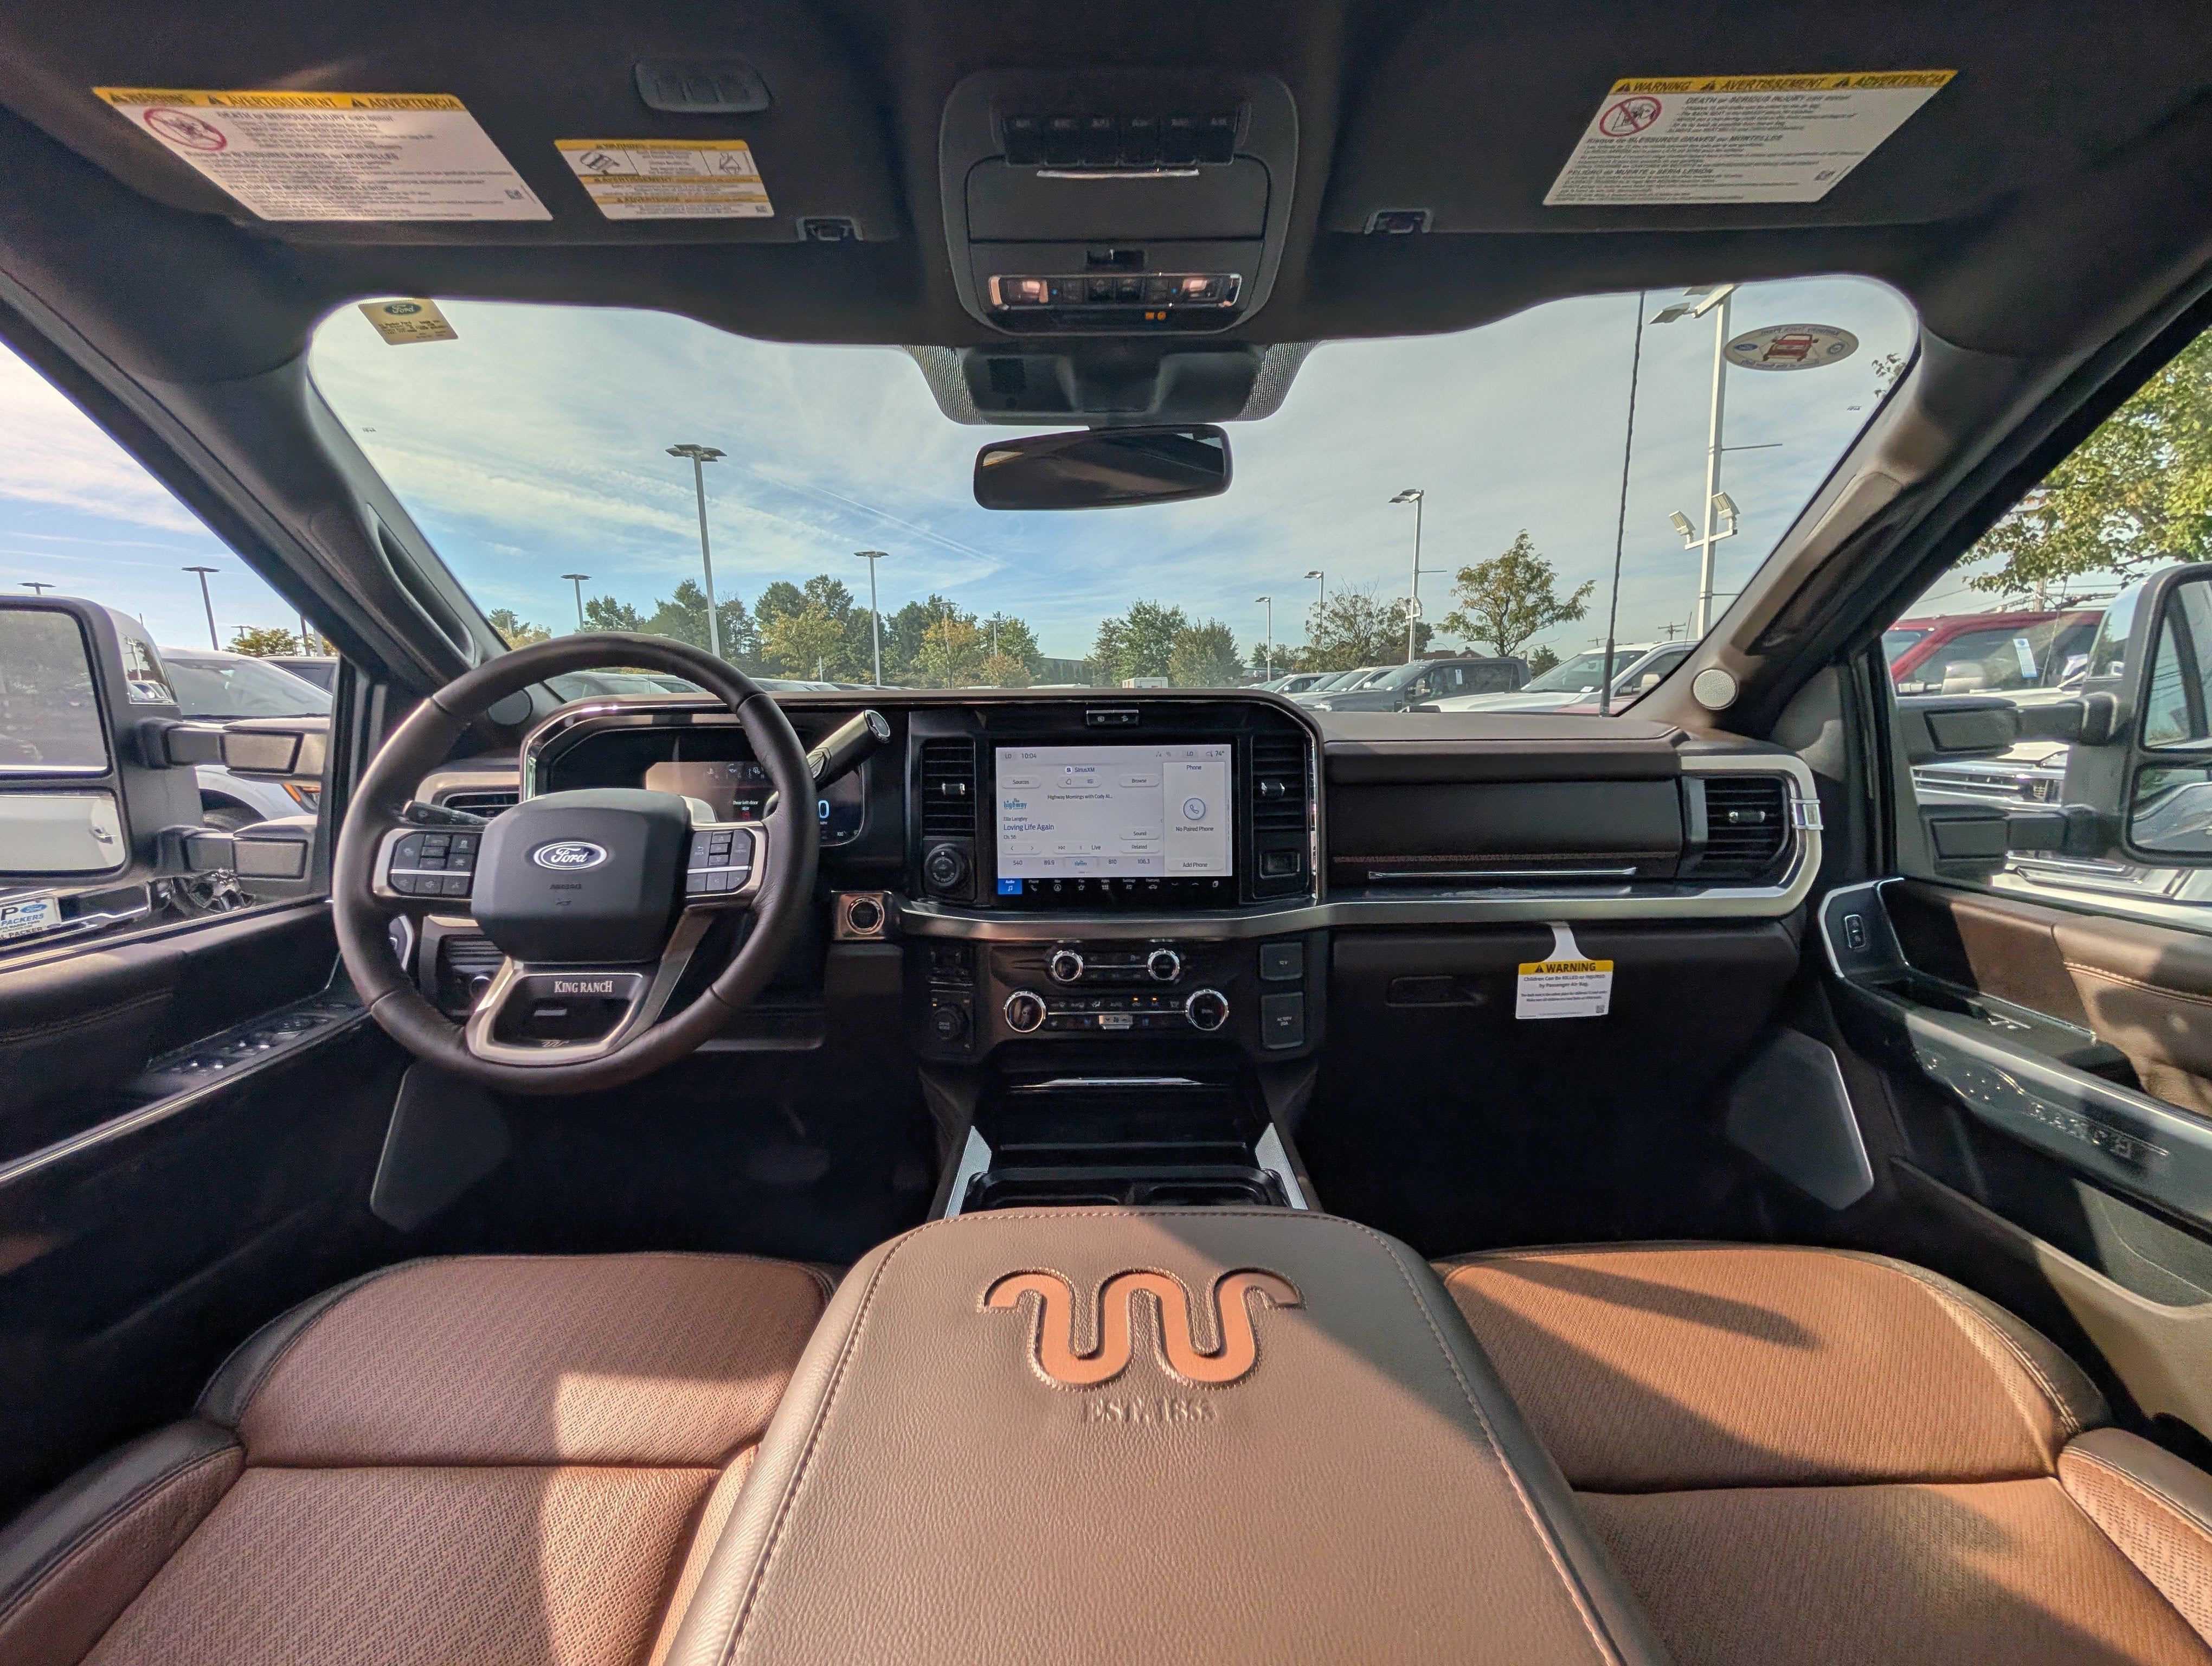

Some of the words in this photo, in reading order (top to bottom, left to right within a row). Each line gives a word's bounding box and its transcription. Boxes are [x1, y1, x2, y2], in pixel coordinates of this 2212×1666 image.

[1631, 80, 1694, 92] WARNING
[222, 95, 339, 107] AVERTISSEMENT
[364, 97, 461, 108] ADVERTENCIA
[818, 800, 829, 819] 0
[1003, 800, 1027, 810] highway
[1003, 824, 1024, 832] Loving
[1037, 823, 1054, 831] Again
[549, 847, 590, 864] Ford
[1, 913, 44, 926] PACKERS
[1546, 962, 1597, 973] WARNING
[554, 981, 579, 993] KING
[580, 980, 613, 993] RANCH
